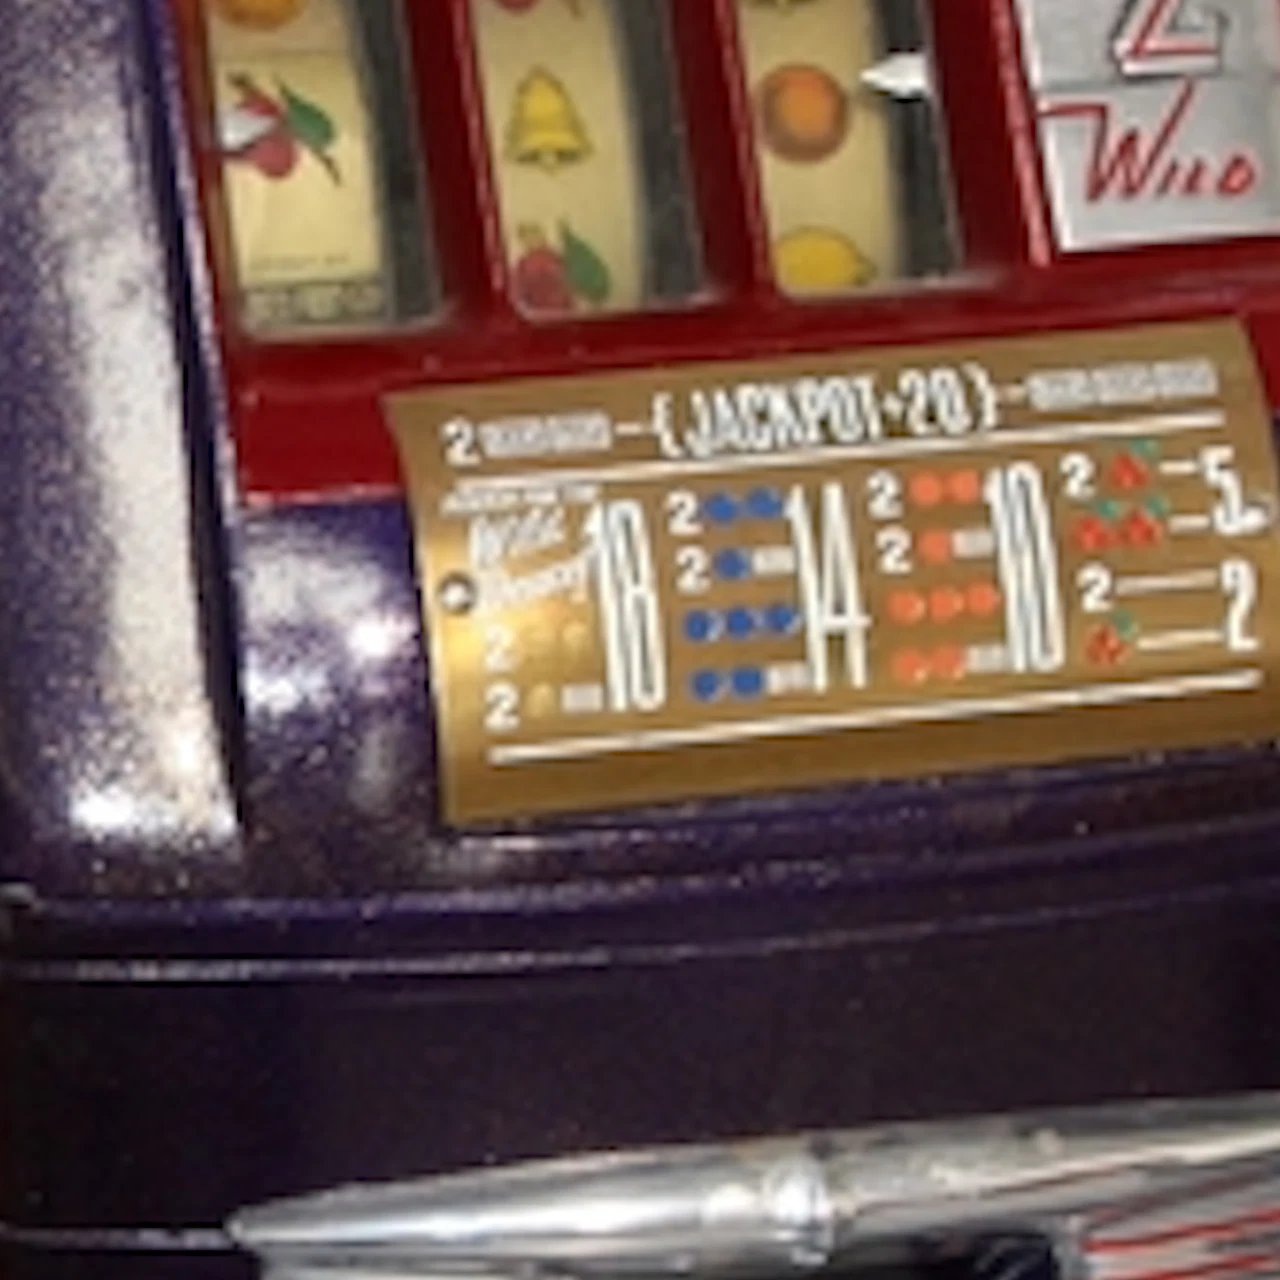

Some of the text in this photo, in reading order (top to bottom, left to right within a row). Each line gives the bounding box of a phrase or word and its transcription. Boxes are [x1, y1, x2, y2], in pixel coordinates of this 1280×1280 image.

[440, 418, 481, 465] 2
[867, 470, 903, 519] 2
[1059, 451, 1096, 499] 2
[665, 489, 705, 536] 2
[675, 545, 712, 595] 2
[875, 524, 914, 574] 2
[983, 460, 1065, 671] 10
[584, 498, 667, 712] 18
[784, 481, 872, 694] 14
[1077, 558, 1259, 651] 2 2
[482, 682, 520, 732] 2
